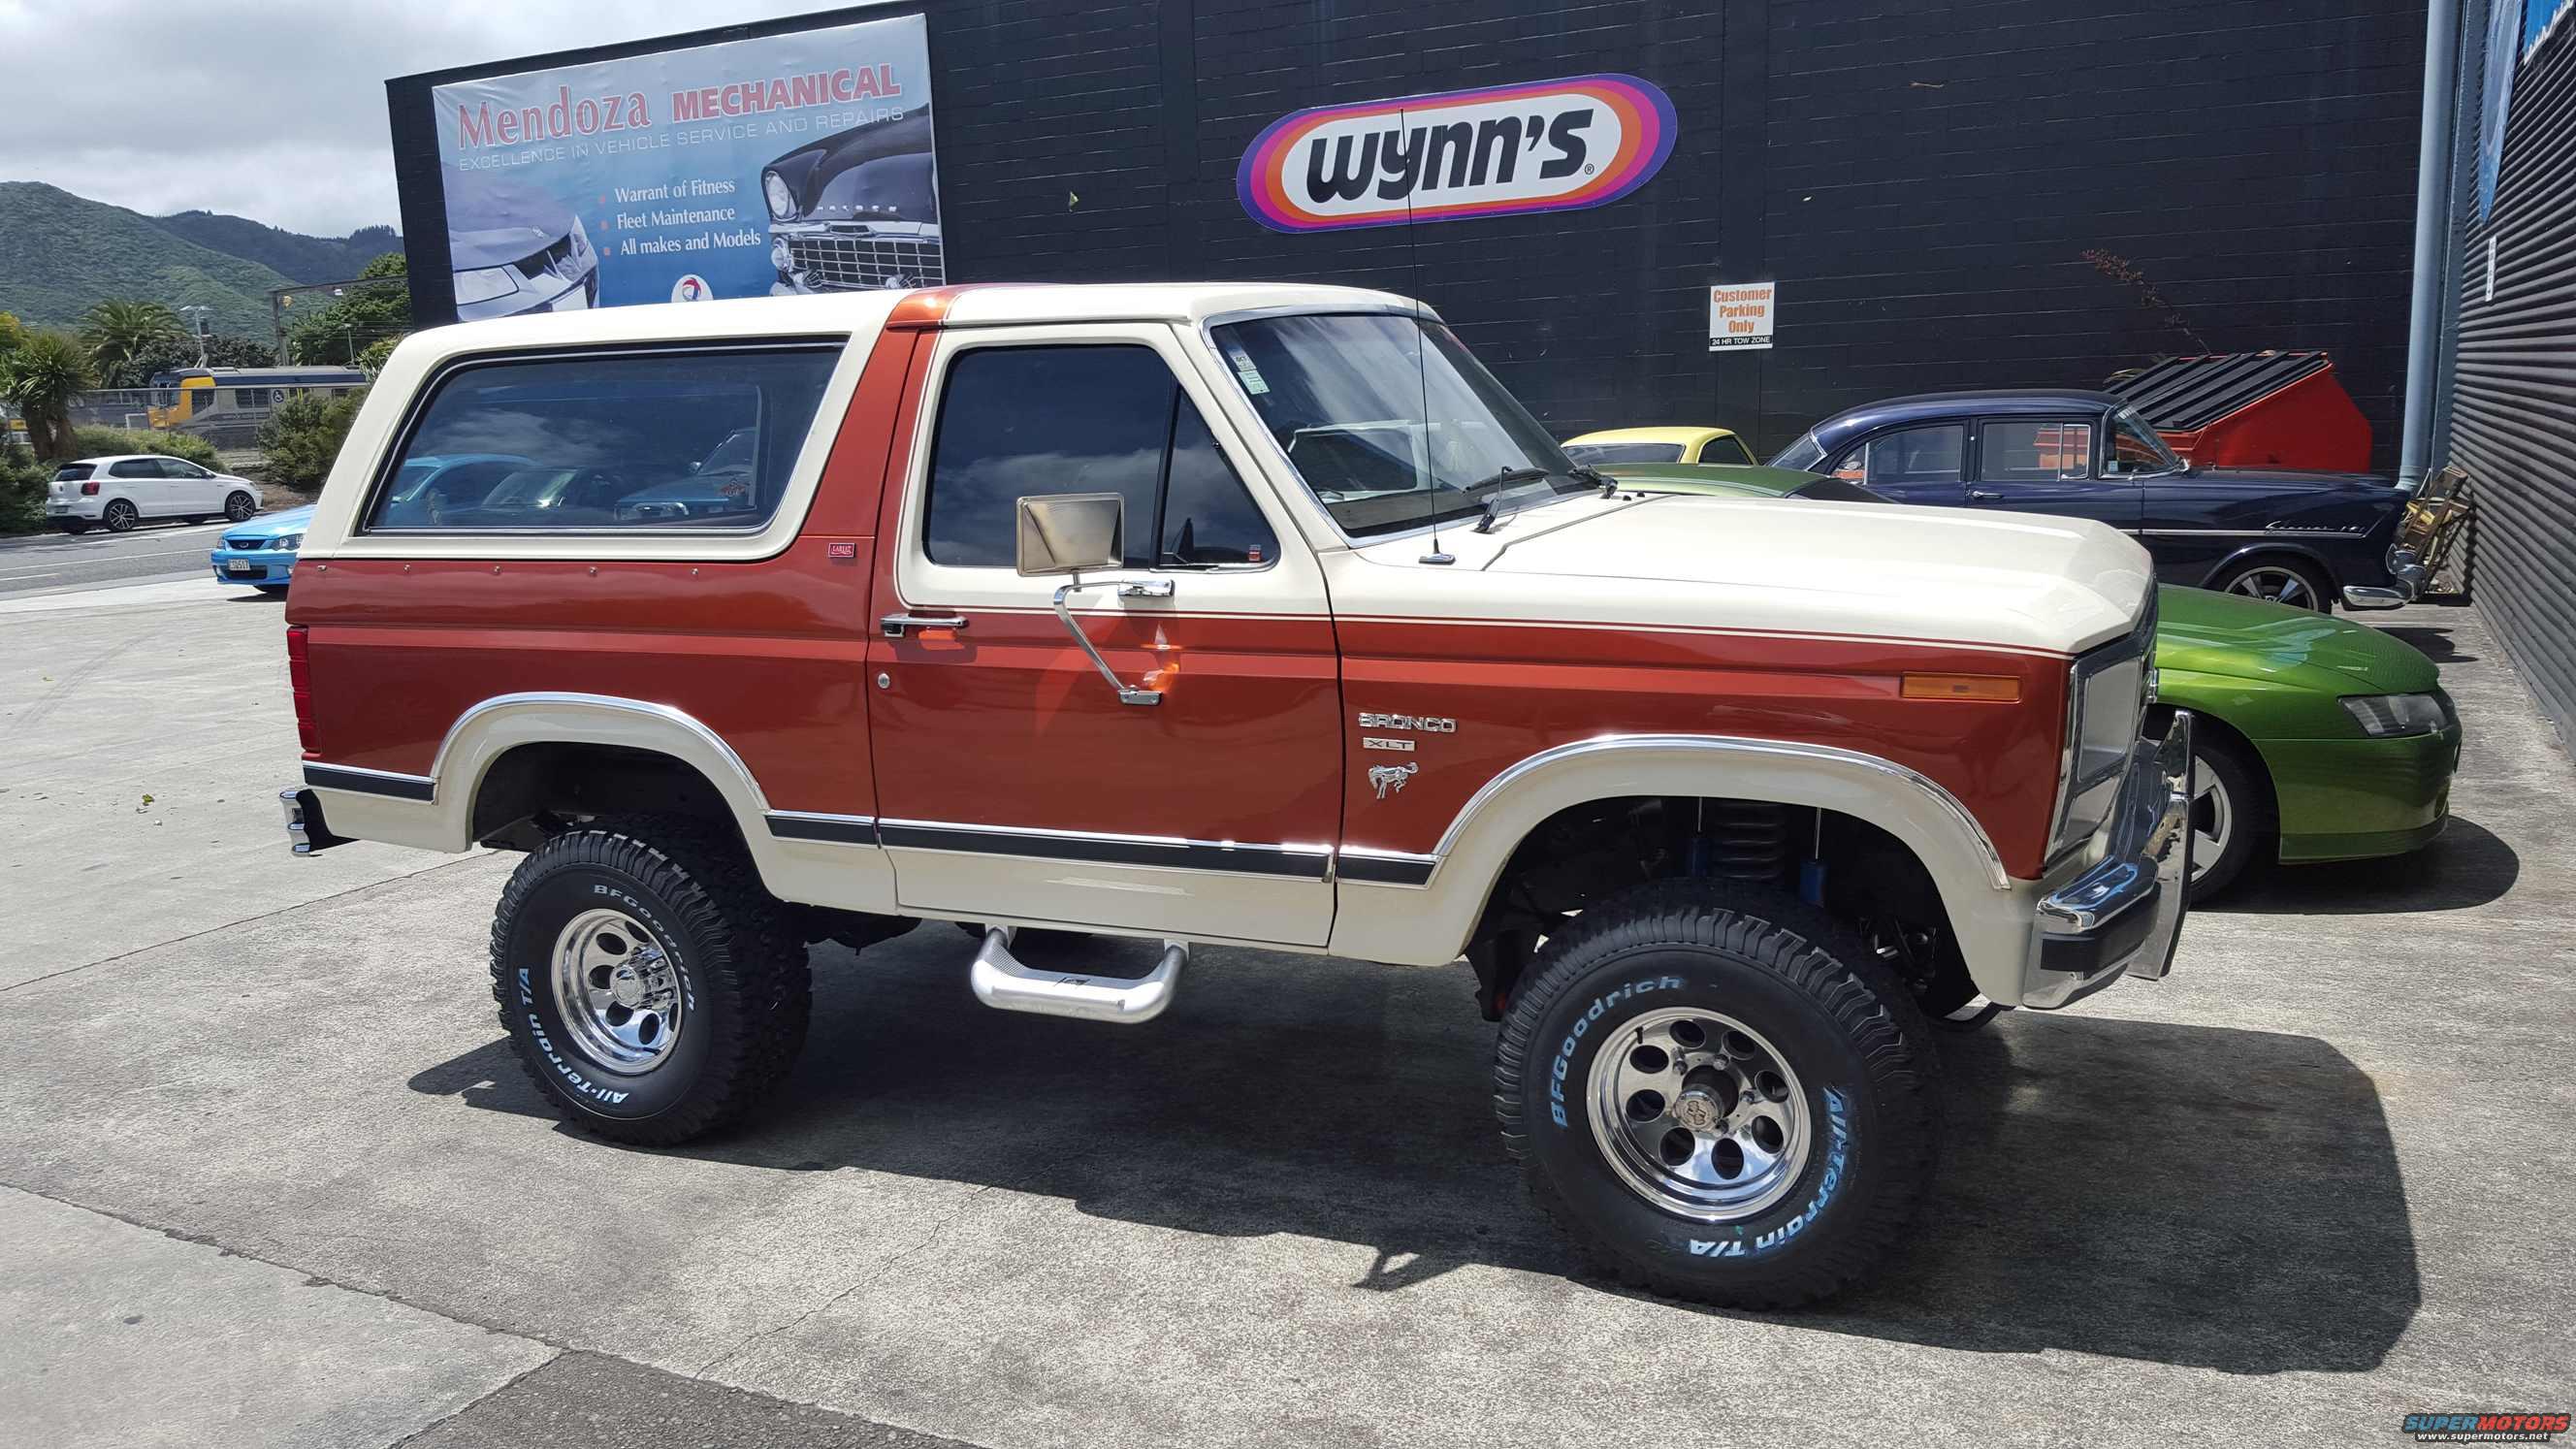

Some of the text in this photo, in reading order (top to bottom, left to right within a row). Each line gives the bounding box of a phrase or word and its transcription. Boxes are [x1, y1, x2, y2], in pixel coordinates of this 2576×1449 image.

[459, 63, 901, 150] Mendoza MECHANICAL
[460, 107, 904, 171] EXCELLENCE IN VEHICLE SERVICE AND REPAIRS
[614, 178, 735, 203] Warrant of Fitness
[617, 208, 735, 230] Fleet Maintenance
[621, 228, 760, 256] All makes and Models
[1714, 289, 1772, 303] Customer
[1720, 304, 1765, 318] Parking
[1728, 319, 1755, 334] Only
[1359, 713, 1456, 733] BRONCO
[1368, 739, 1413, 750] XLT
[519, 968, 629, 1104] All-Terrain T/A
[1551, 976, 1684, 1127] BFGoodrich
[1690, 1239, 1746, 1258] T/A
